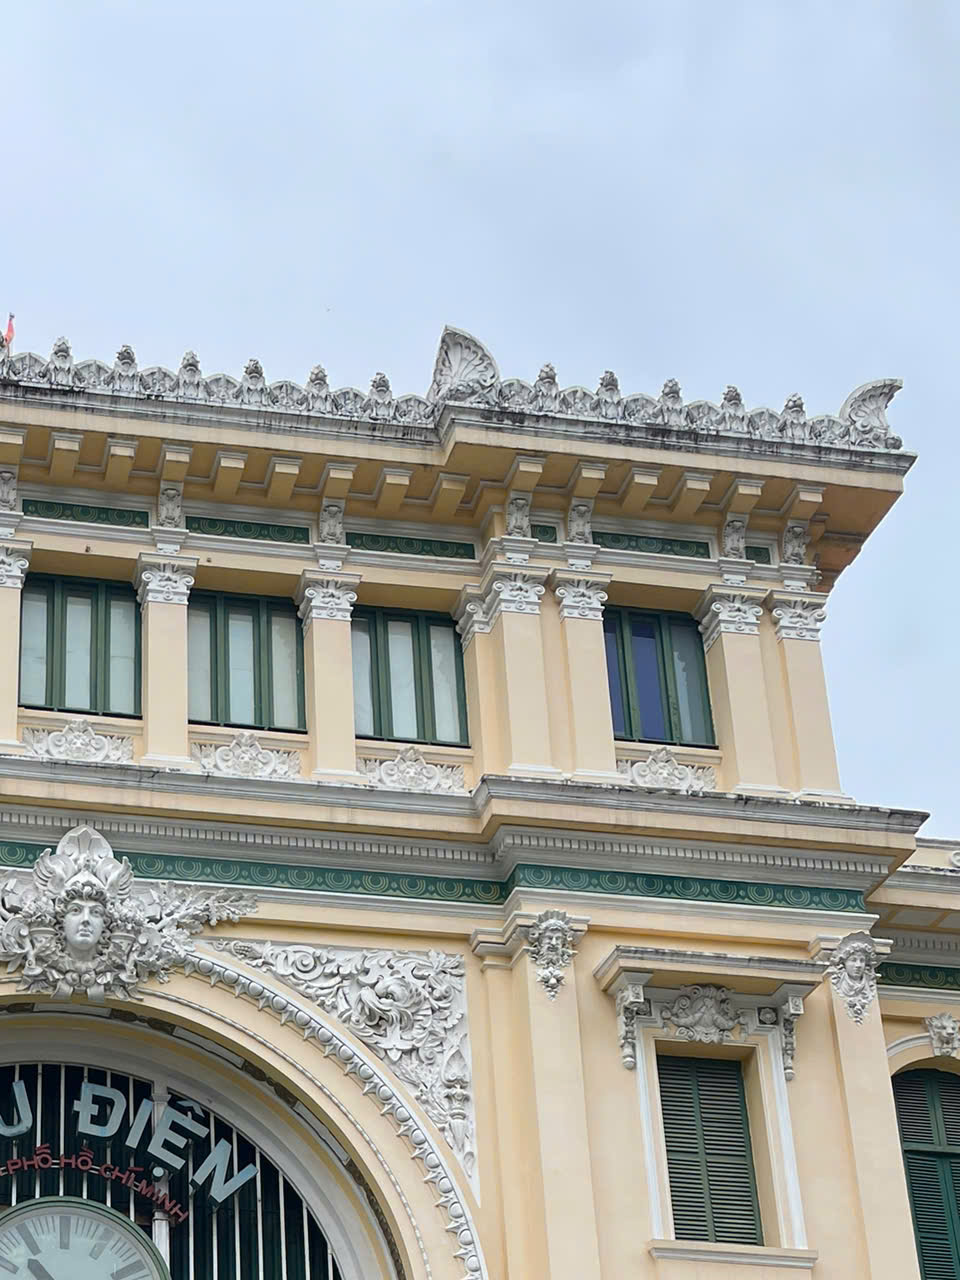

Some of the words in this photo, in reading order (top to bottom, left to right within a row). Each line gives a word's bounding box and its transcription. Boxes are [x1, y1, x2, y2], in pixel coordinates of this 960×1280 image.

[73, 1081, 259, 1204] ĐIỆN
[100, 1163, 144, 1187] CHÍ
[139, 1179, 189, 1222] MINH
